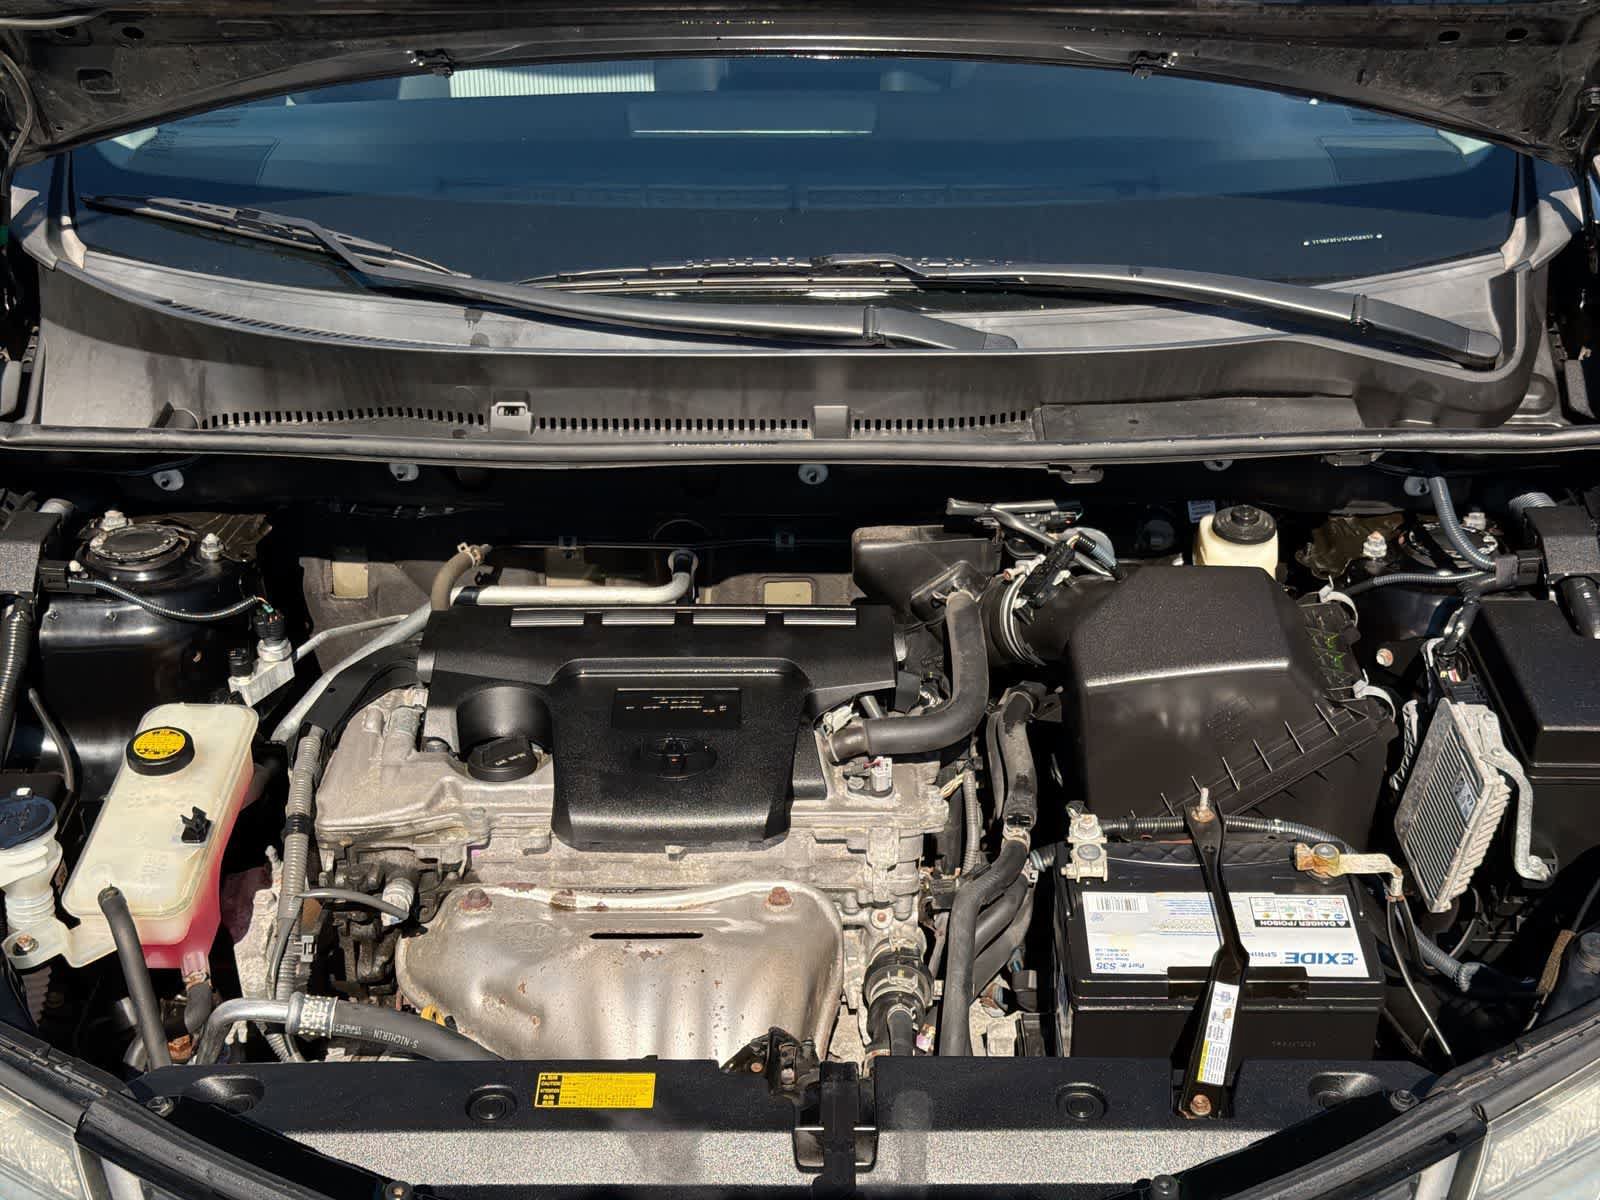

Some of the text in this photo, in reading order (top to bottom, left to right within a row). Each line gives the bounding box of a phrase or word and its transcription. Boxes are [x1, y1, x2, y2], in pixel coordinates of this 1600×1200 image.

[1284, 951, 1357, 965] EXIDE
[1095, 961, 1117, 970] S35
[1127, 961, 1145, 969] Part
